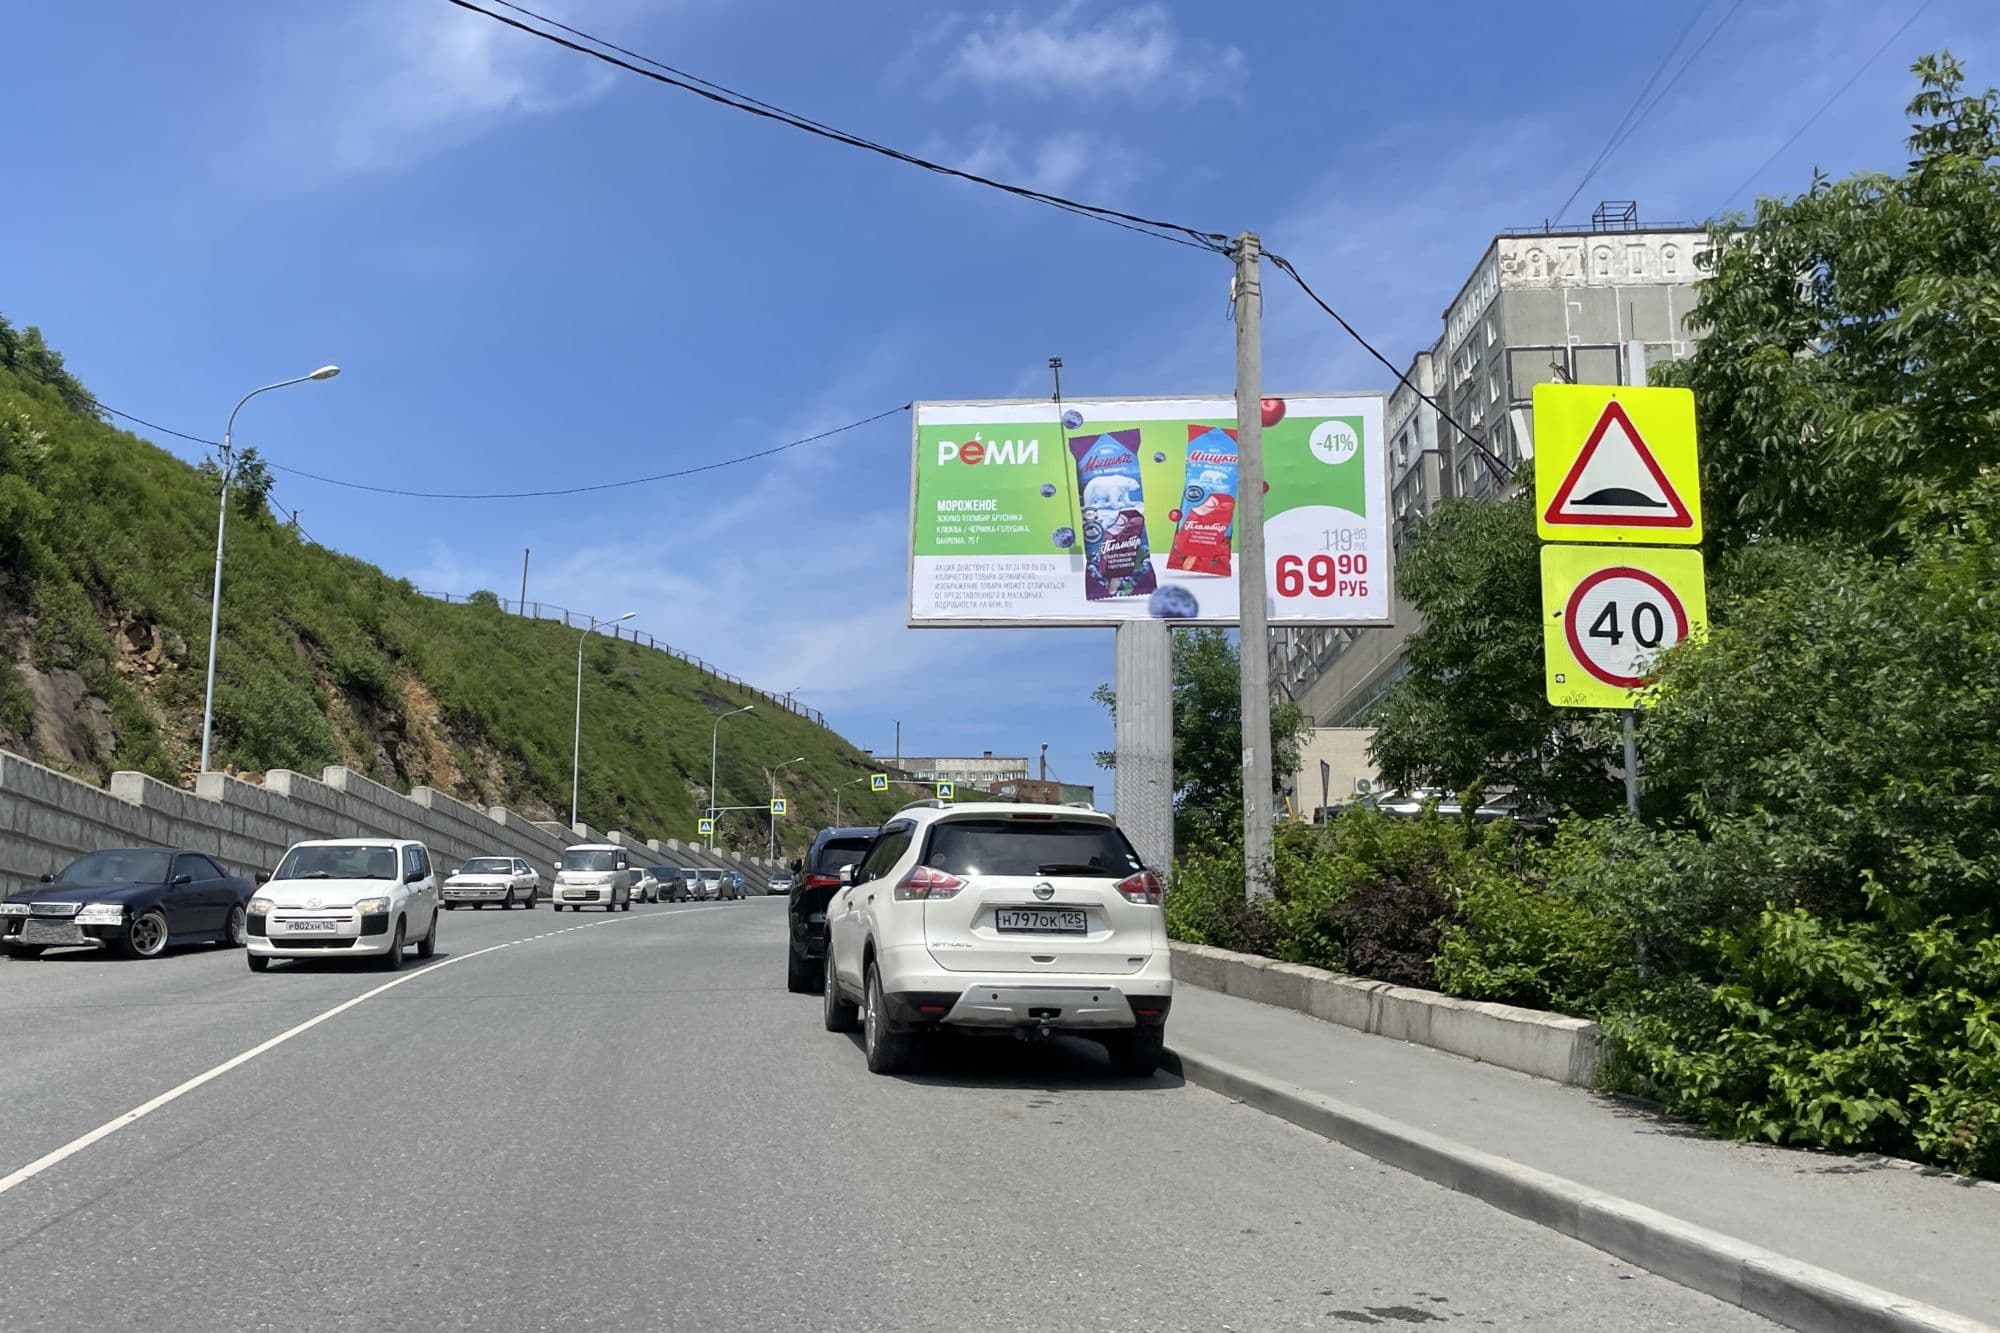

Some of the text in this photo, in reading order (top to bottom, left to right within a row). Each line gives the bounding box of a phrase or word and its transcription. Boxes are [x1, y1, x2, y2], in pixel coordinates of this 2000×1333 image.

[1316, 433, 1354, 452] -41%
[937, 499, 998, 512] МОРОЖЕНОЕ
[1276, 554, 1368, 598] 69 90
[1004, 582, 1025, 590] МОЖЕТ
[1027, 581, 1065, 590] ОТЛИЧАТЬСЯ
[1339, 580, 1368, 597] РУБ
[1589, 601, 1664, 649] 40
[1002, 912, 1081, 928] Н797ОК 125
